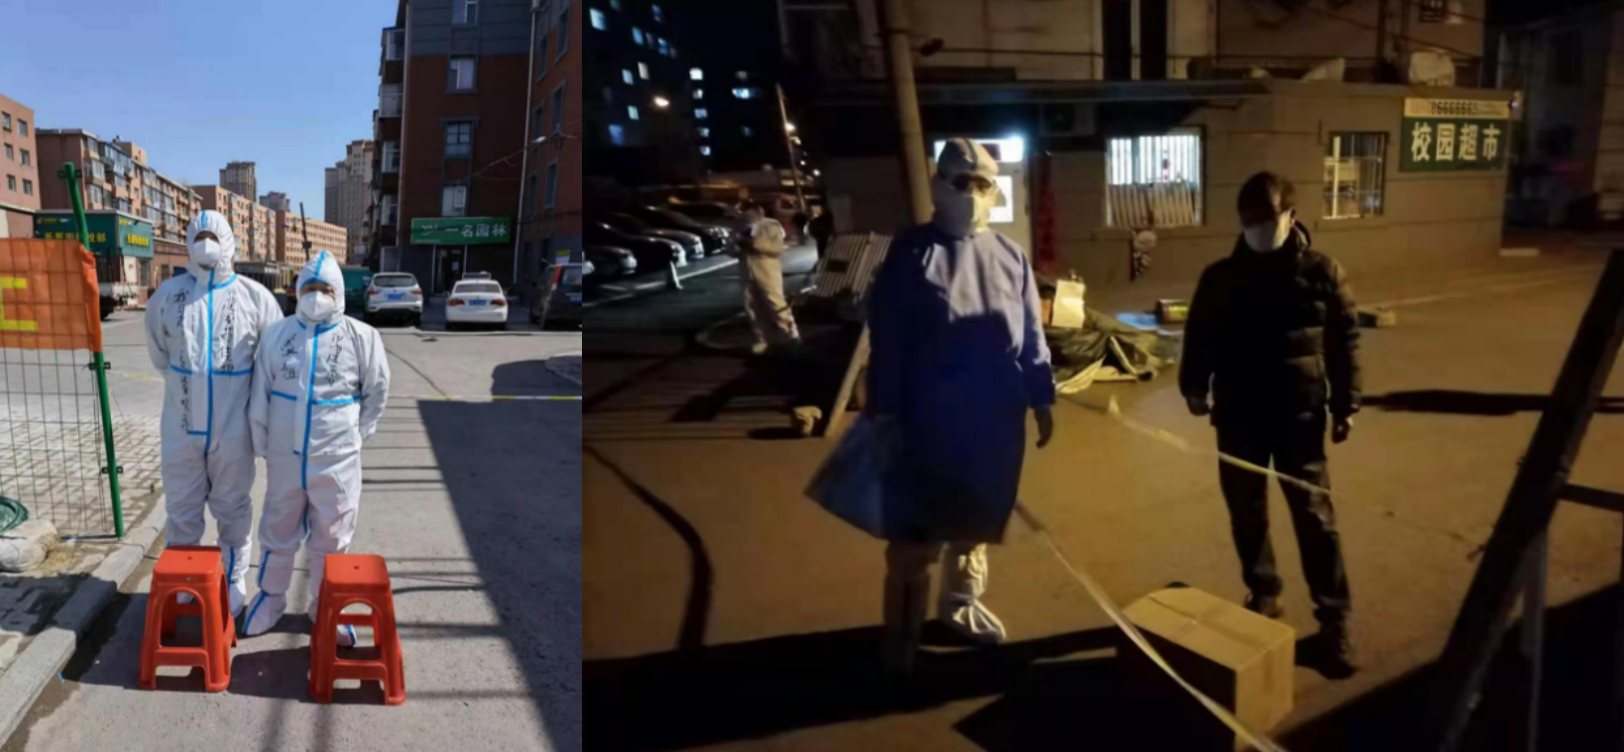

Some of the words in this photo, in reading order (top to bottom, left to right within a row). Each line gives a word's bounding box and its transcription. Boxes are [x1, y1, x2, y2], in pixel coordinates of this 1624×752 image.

[1410, 121, 1501, 162] 校园超市
[445, 223, 506, 238] 一名园林
